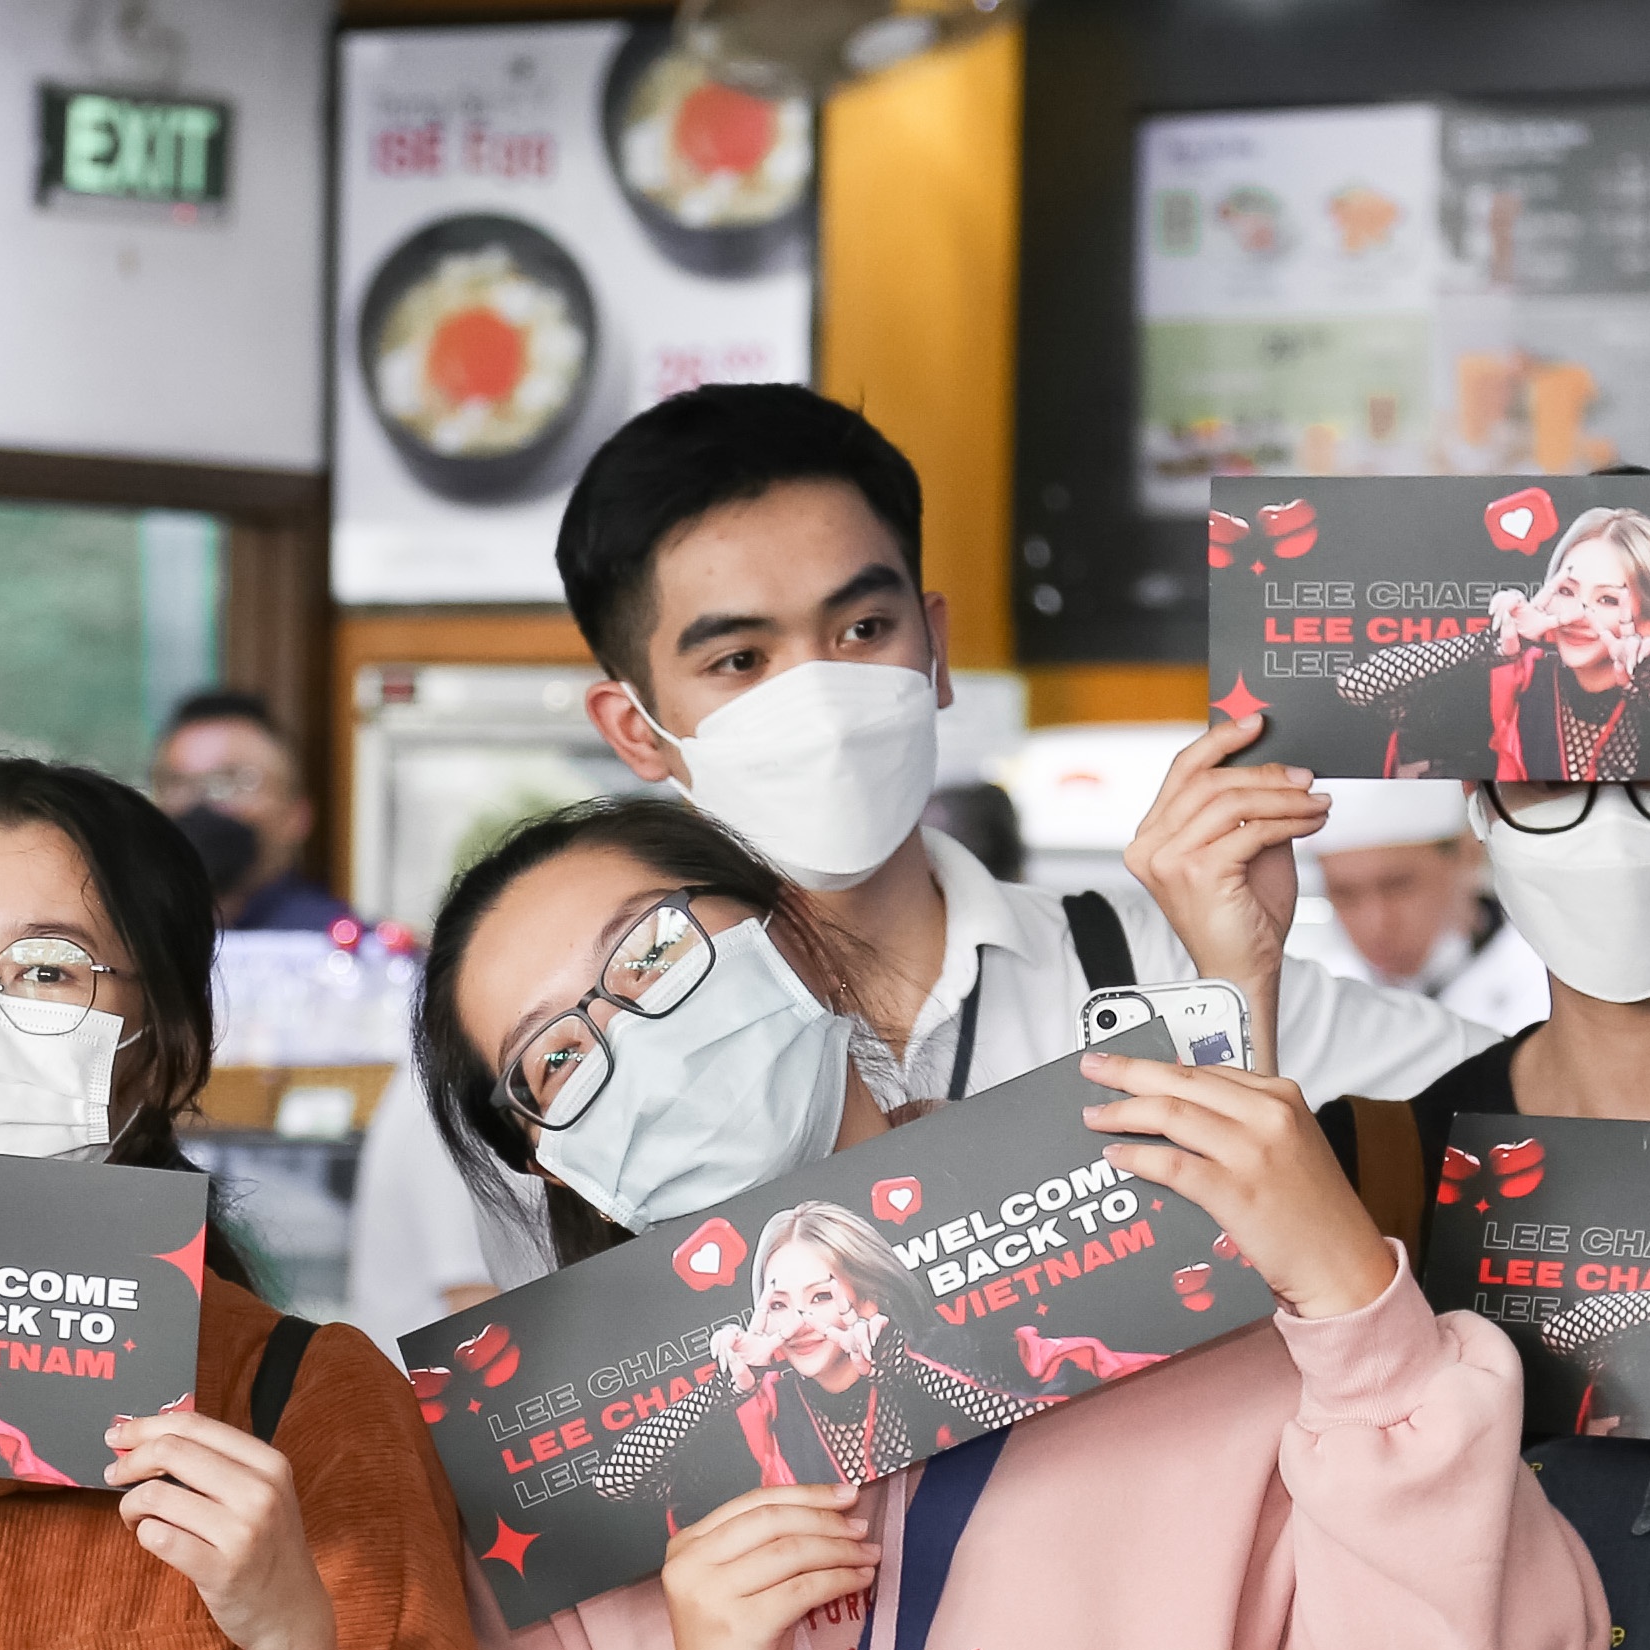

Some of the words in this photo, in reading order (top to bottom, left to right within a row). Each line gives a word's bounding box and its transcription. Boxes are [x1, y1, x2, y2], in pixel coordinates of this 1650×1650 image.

[64, 94, 218, 200] EXIT
[1264, 582, 1354, 608] LEE
[1264, 617, 1353, 642] LEE
[926, 1216, 1069, 1298] BACK
[1067, 1187, 1140, 1235] TO
[1484, 1220, 1570, 1252] LEE
[934, 1218, 1156, 1326] VIETNAM
[1479, 1255, 1565, 1287] LEE
[51, 1307, 116, 1345] TO
[487, 1381, 582, 1442] LEE
[499, 1415, 593, 1475] LEE
